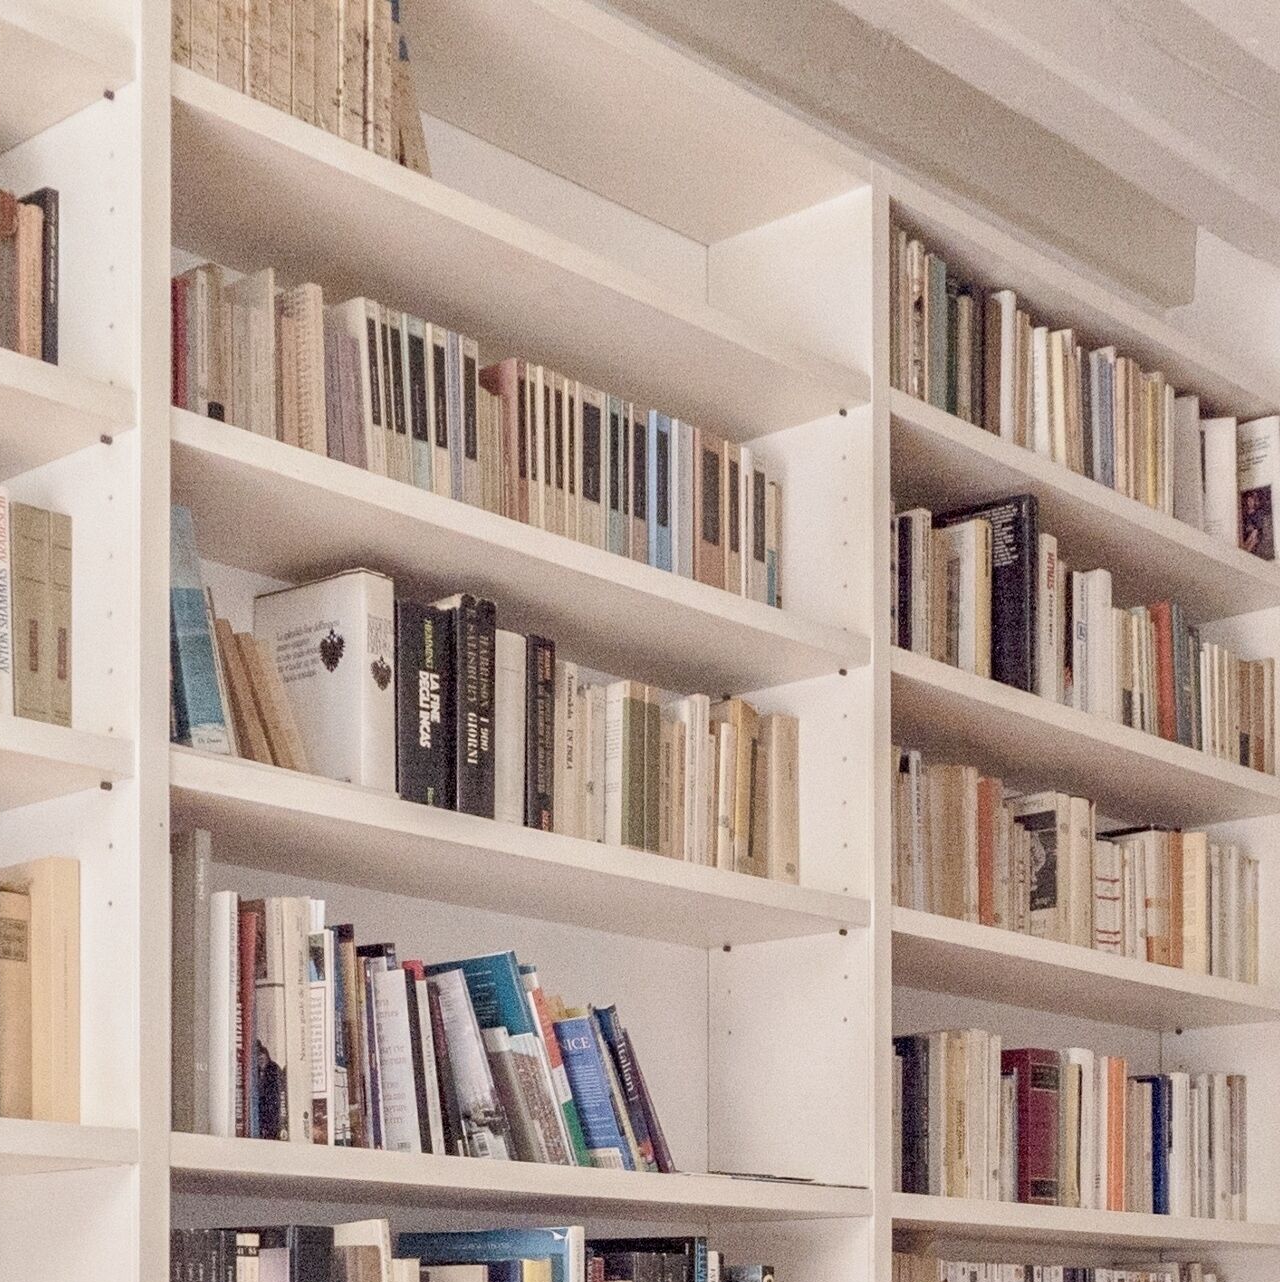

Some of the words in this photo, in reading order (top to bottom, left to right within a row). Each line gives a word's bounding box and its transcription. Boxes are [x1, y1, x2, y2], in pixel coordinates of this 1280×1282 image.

[430, 673, 440, 691] LA
[466, 624, 478, 703] SALISBURY
[479, 634, 490, 708] HARRISON
[418, 670, 430, 706] DEGLI
[418, 709, 430, 748] INCAS
[430, 697, 440, 723] FINE
[466, 711, 478, 765] GIORNI
[480, 726, 490, 752] 900
